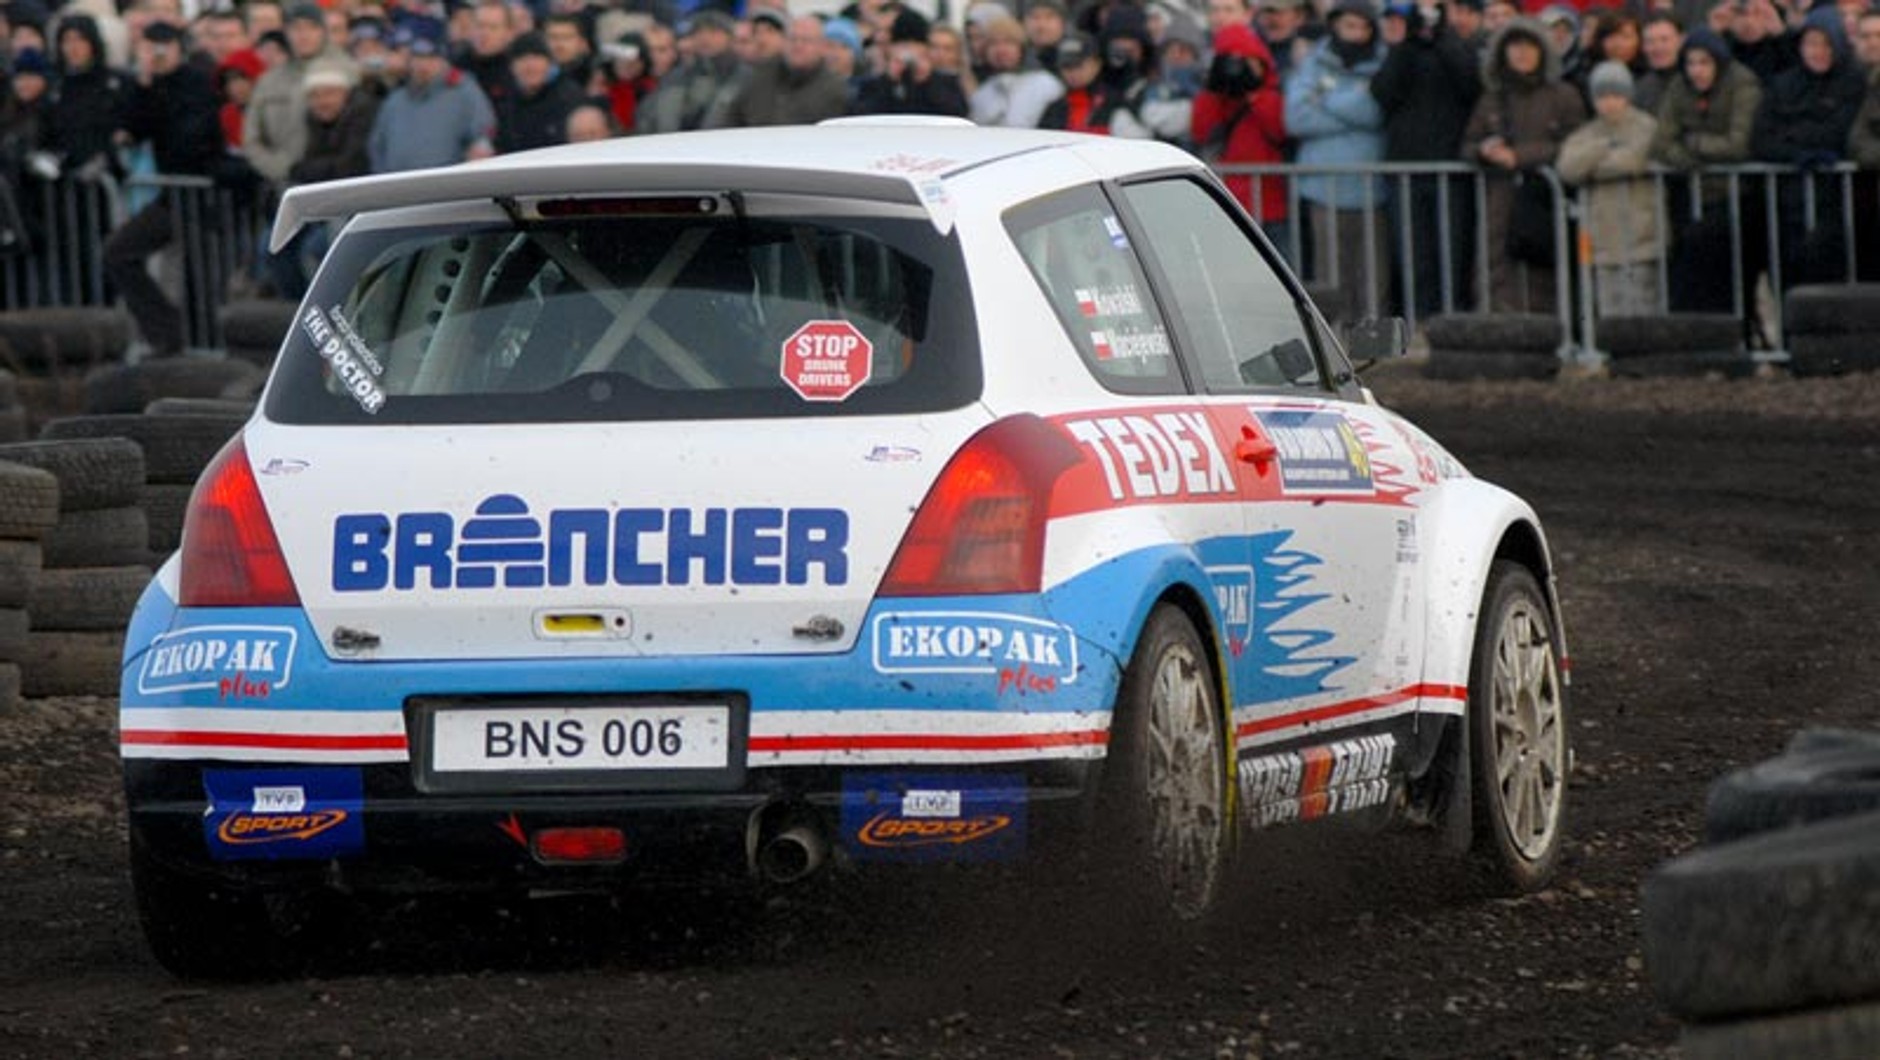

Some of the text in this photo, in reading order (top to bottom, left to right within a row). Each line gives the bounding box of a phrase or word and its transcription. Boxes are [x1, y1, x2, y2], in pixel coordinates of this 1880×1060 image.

[304, 307, 384, 409] THE DOCTOR
[795, 333, 859, 358] STOP
[798, 373, 852, 387] DRIVERS
[803, 359, 848, 372] DRUNK
[1065, 412, 1237, 500] TEDEX
[332, 493, 849, 592] BRANCHER
[150, 638, 280, 678] EKOPAK
[888, 625, 1061, 666] EKOPAK
[218, 669, 270, 699] plus
[997, 662, 1056, 697] plus
[485, 718, 683, 758] BNS 006
[261, 792, 297, 807] TVP
[231, 815, 326, 834] SPORT
[873, 819, 984, 838] SPORT
